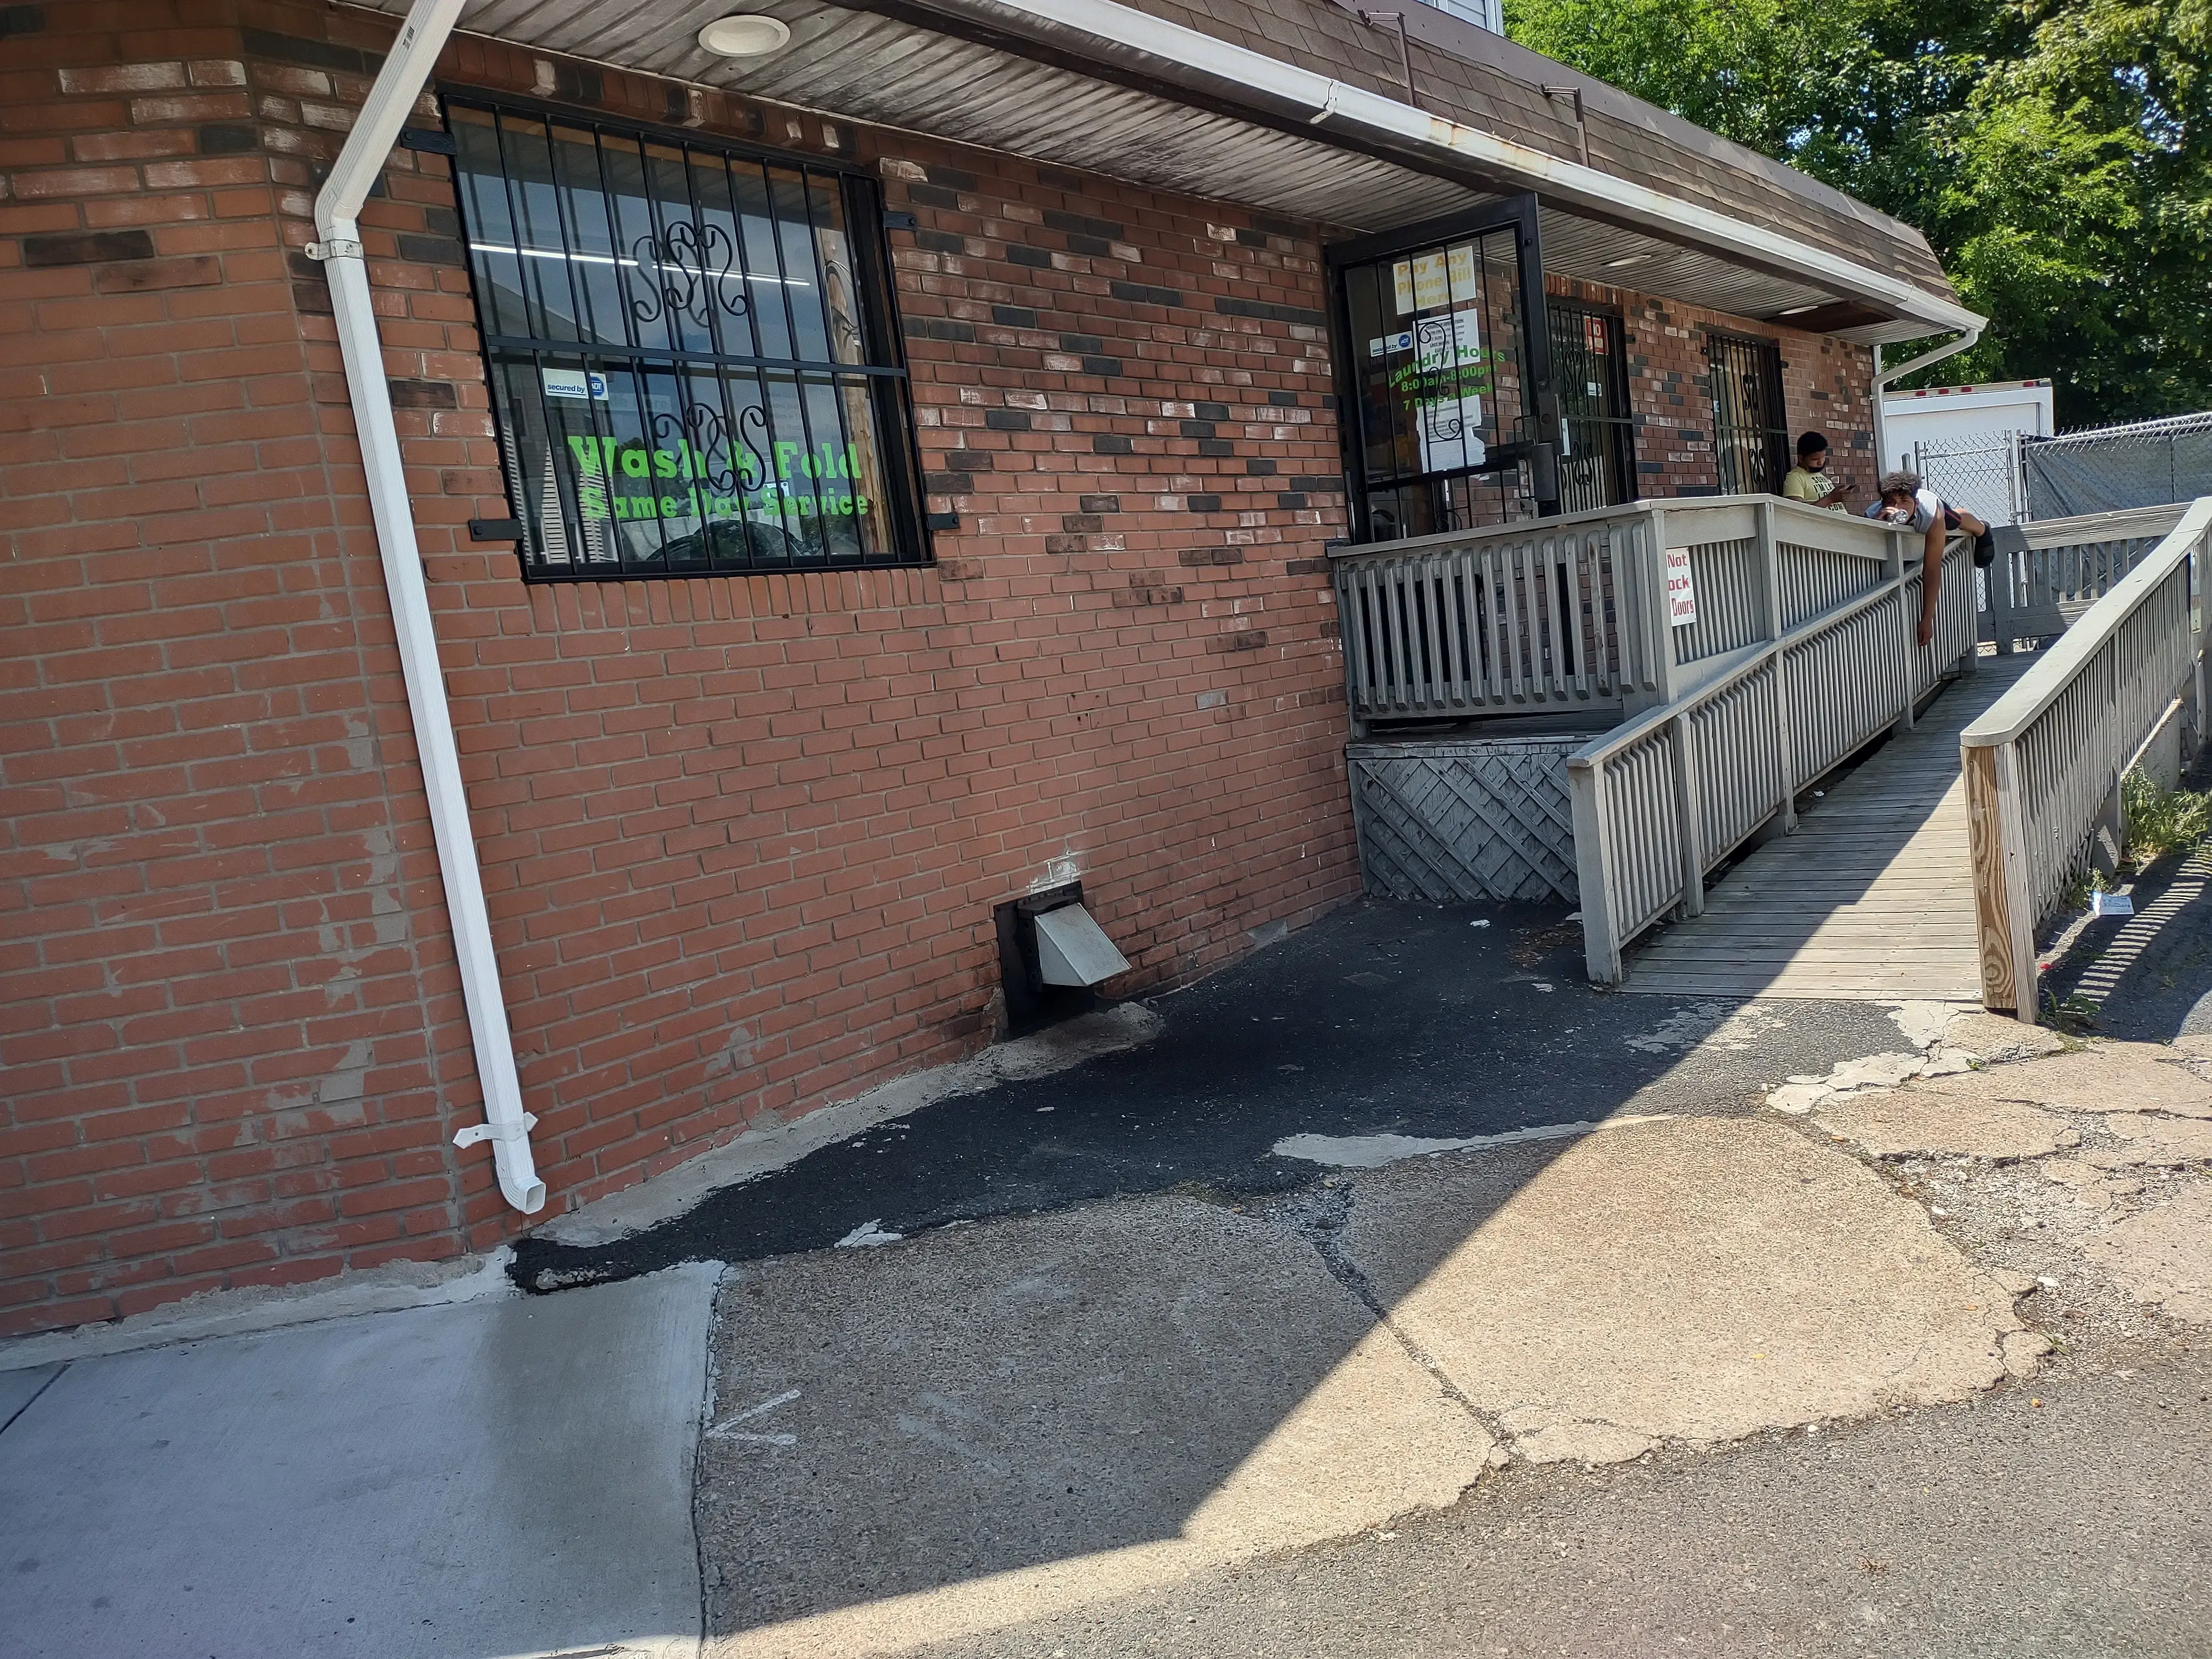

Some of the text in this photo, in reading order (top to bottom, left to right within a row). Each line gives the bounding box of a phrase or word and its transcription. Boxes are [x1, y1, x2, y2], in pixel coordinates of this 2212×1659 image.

[1435, 252, 1467, 268] Any
[1397, 266, 1471, 296] Phone Bill
[1400, 337, 1410, 345] ADT
[1389, 350, 1449, 388] Laundry
[1457, 345, 1506, 362] Hours
[547, 384, 576, 392] secured
[1402, 399, 1410, 411] 7
[1415, 395, 1444, 408] Days
[1447, 392, 1456, 401] a
[568, 436, 862, 479] Wash & Fold
[1813, 484, 1825, 493] I'M
[581, 487, 868, 524] Same Day Service
[1667, 554, 1687, 568] Not
[1668, 574, 1690, 591] ock
[1671, 598, 1694, 617] Doors
